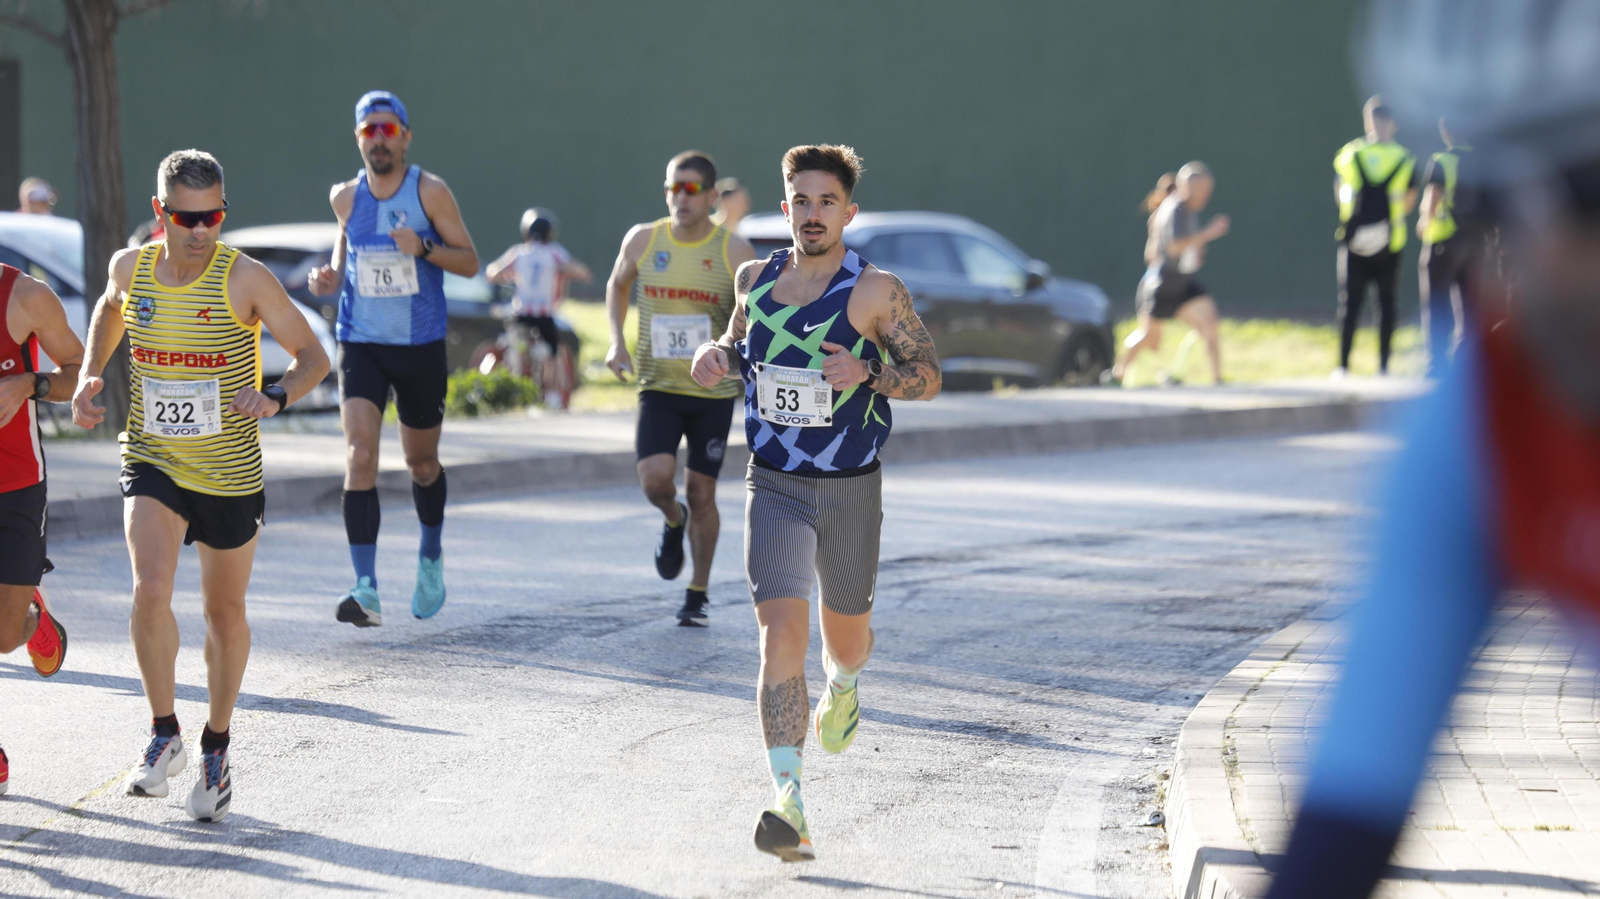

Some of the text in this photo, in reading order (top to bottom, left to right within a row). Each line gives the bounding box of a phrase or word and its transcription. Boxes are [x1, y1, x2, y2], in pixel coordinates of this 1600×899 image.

[372, 268, 392, 287] 76
[668, 331, 688, 349] 36
[775, 387, 800, 412] 53
[155, 401, 195, 424] 232
[774, 414, 811, 425] EVOS
[160, 427, 201, 436] EVOS
